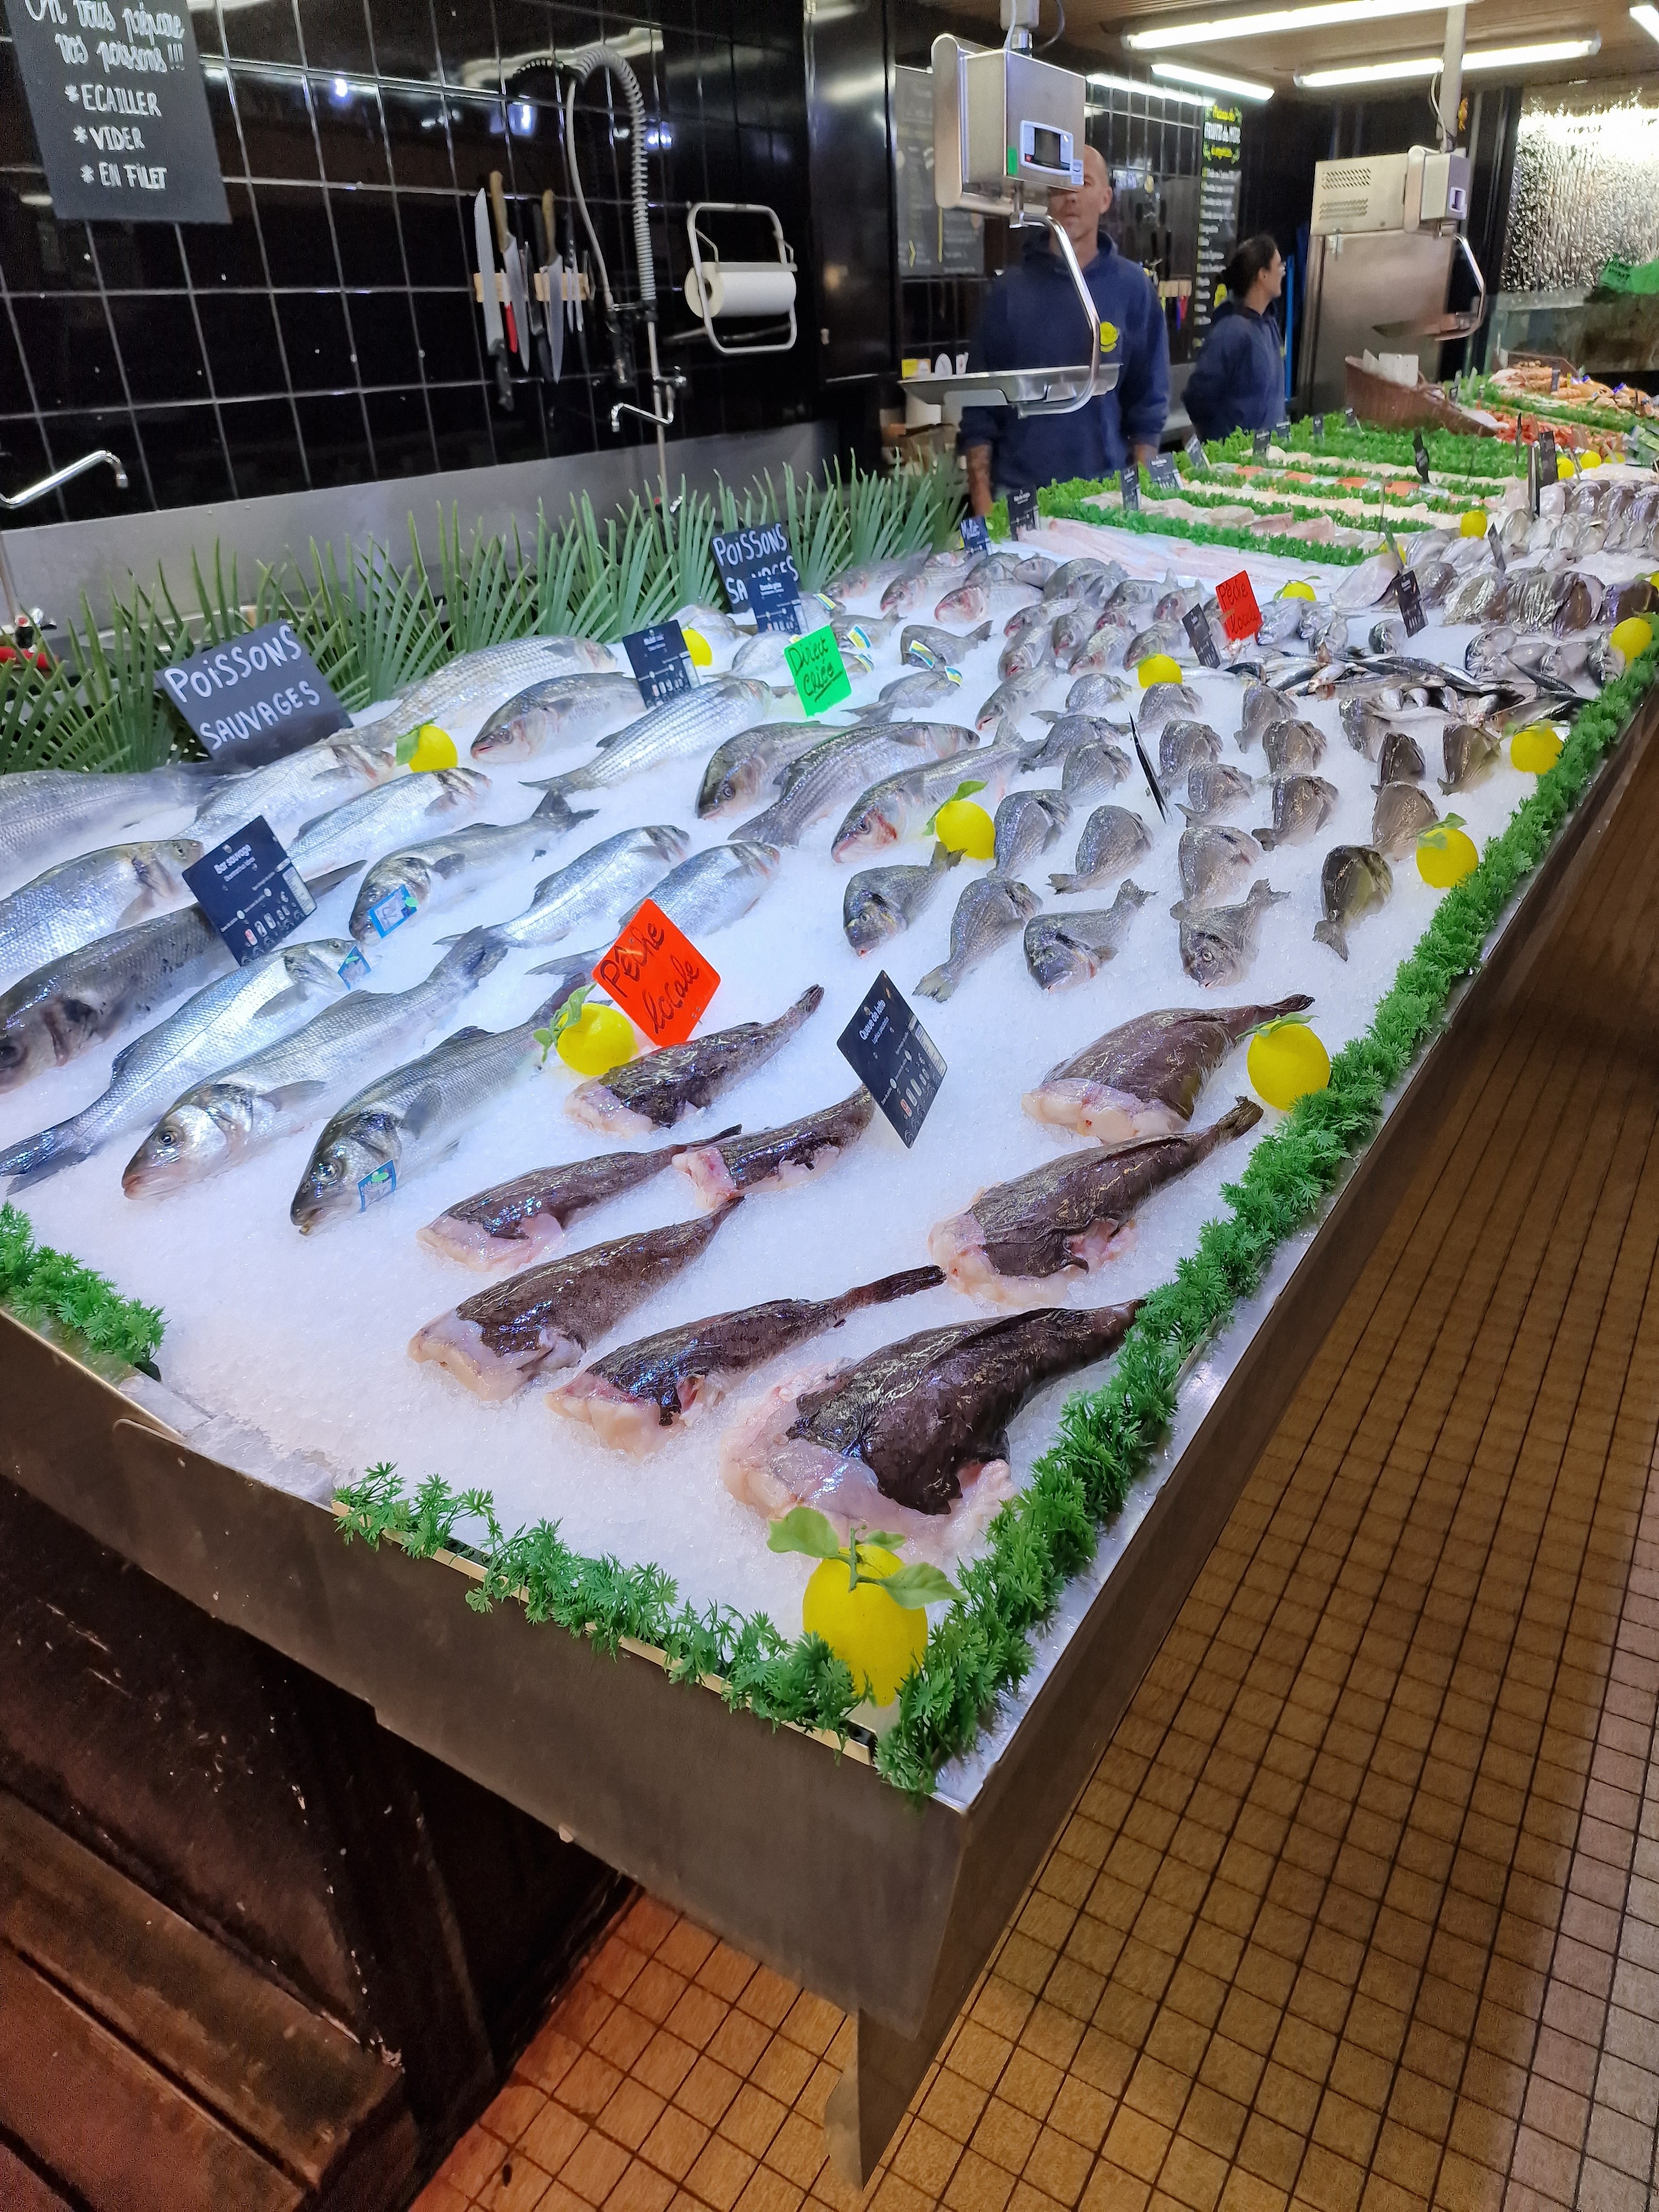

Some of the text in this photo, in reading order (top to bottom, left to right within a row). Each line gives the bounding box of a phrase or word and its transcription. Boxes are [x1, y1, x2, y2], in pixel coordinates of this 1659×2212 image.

[89, 127, 145, 151] VIDER
[98, 161, 122, 187] EN
[200, 680, 321, 751] SAUVAGES
[213, 861, 228, 874] Bar
[226, 844, 253, 867] sauvage
[600, 922, 665, 998] Pêche
[641, 954, 700, 1035] locale
[859, 999, 886, 1040] Queue de lotte
